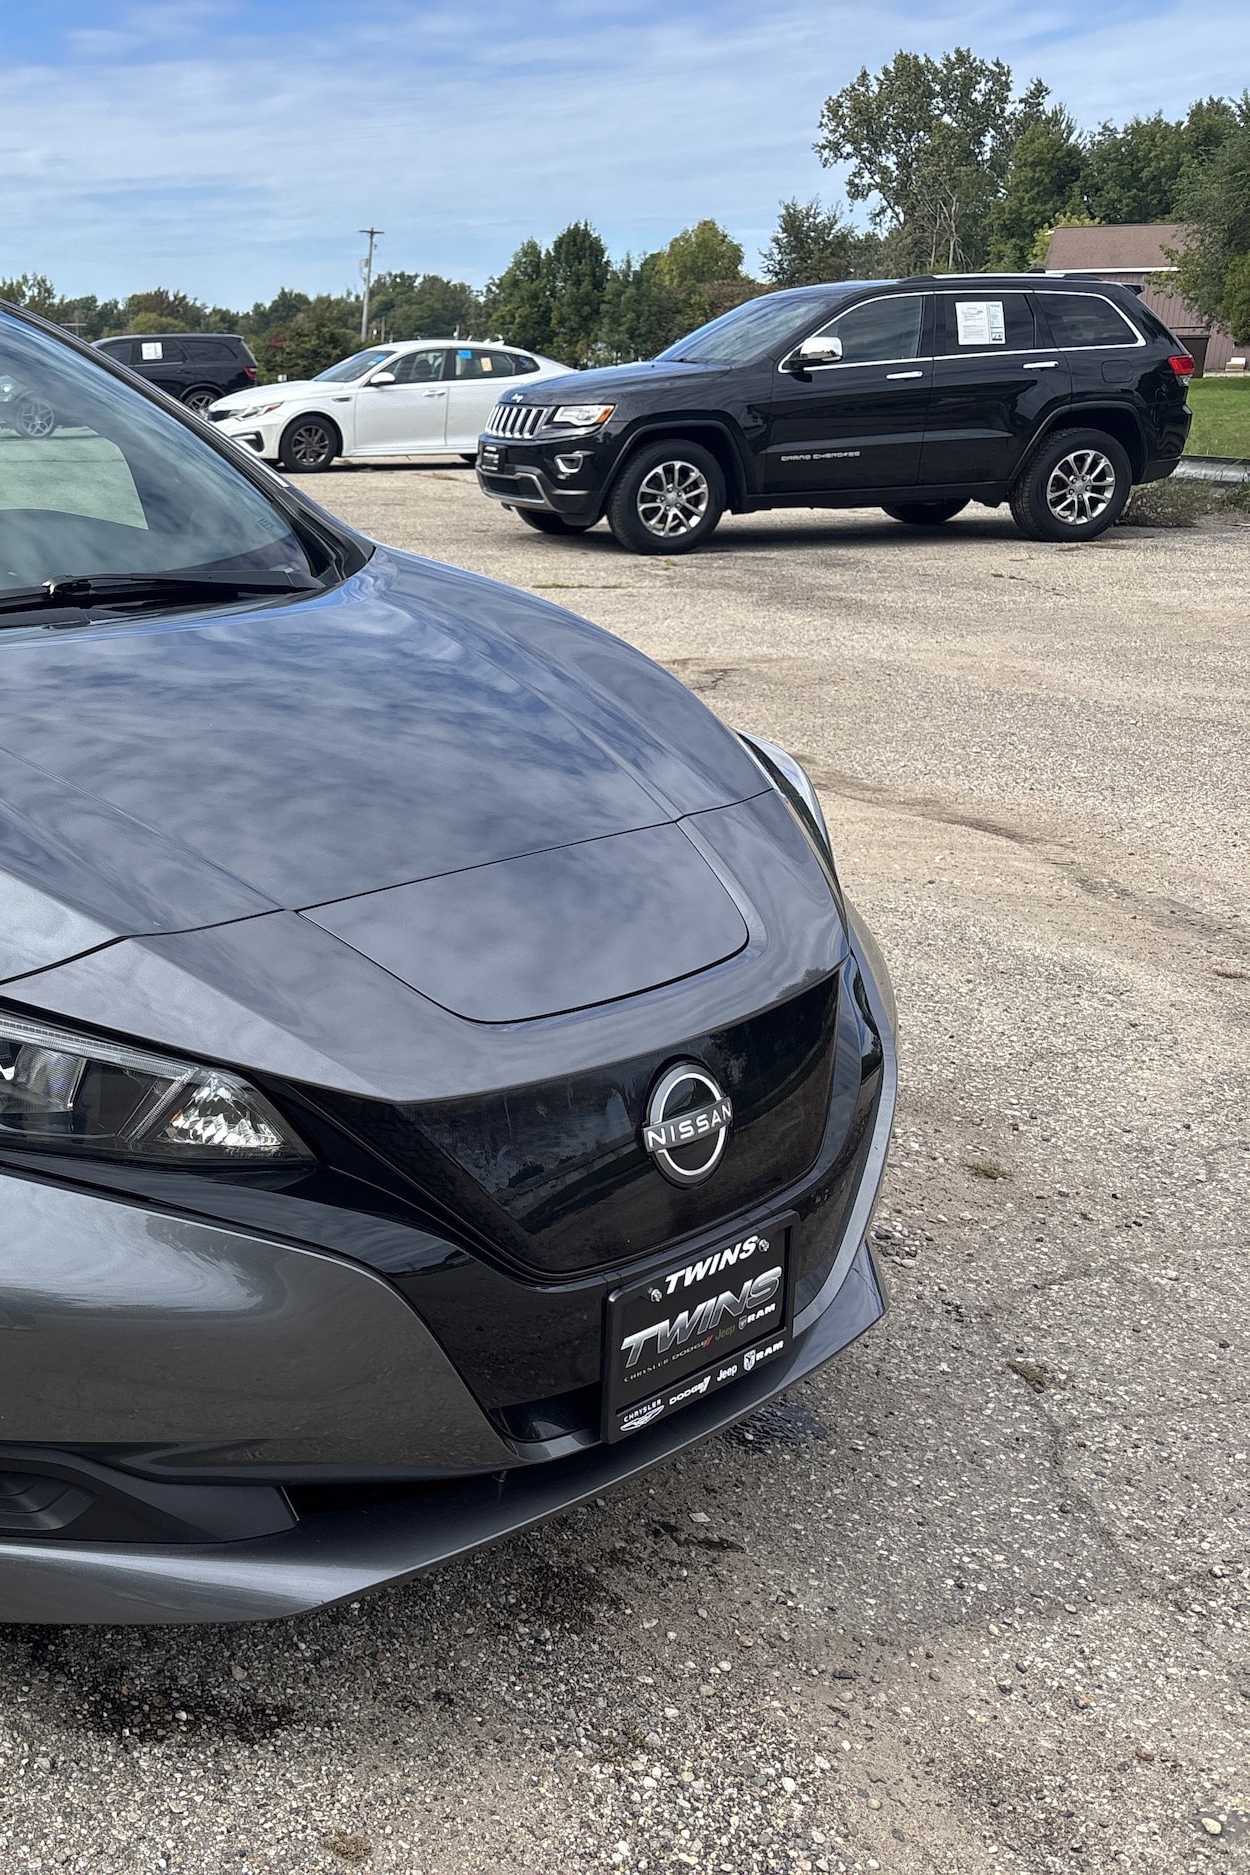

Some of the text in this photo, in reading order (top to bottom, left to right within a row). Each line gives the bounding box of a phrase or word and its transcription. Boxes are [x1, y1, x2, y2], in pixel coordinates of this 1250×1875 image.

[647, 1101, 732, 1148] NISSAN
[665, 1235, 758, 1295] TWINS
[620, 1265, 782, 1368] TWINS
[623, 1359, 669, 1382] CHRYSLER
[715, 1324, 736, 1341] Jeep
[747, 1302, 776, 1324] RAM
[623, 1340, 784, 1423] CHRYSLER DODGE Jeep RAM
